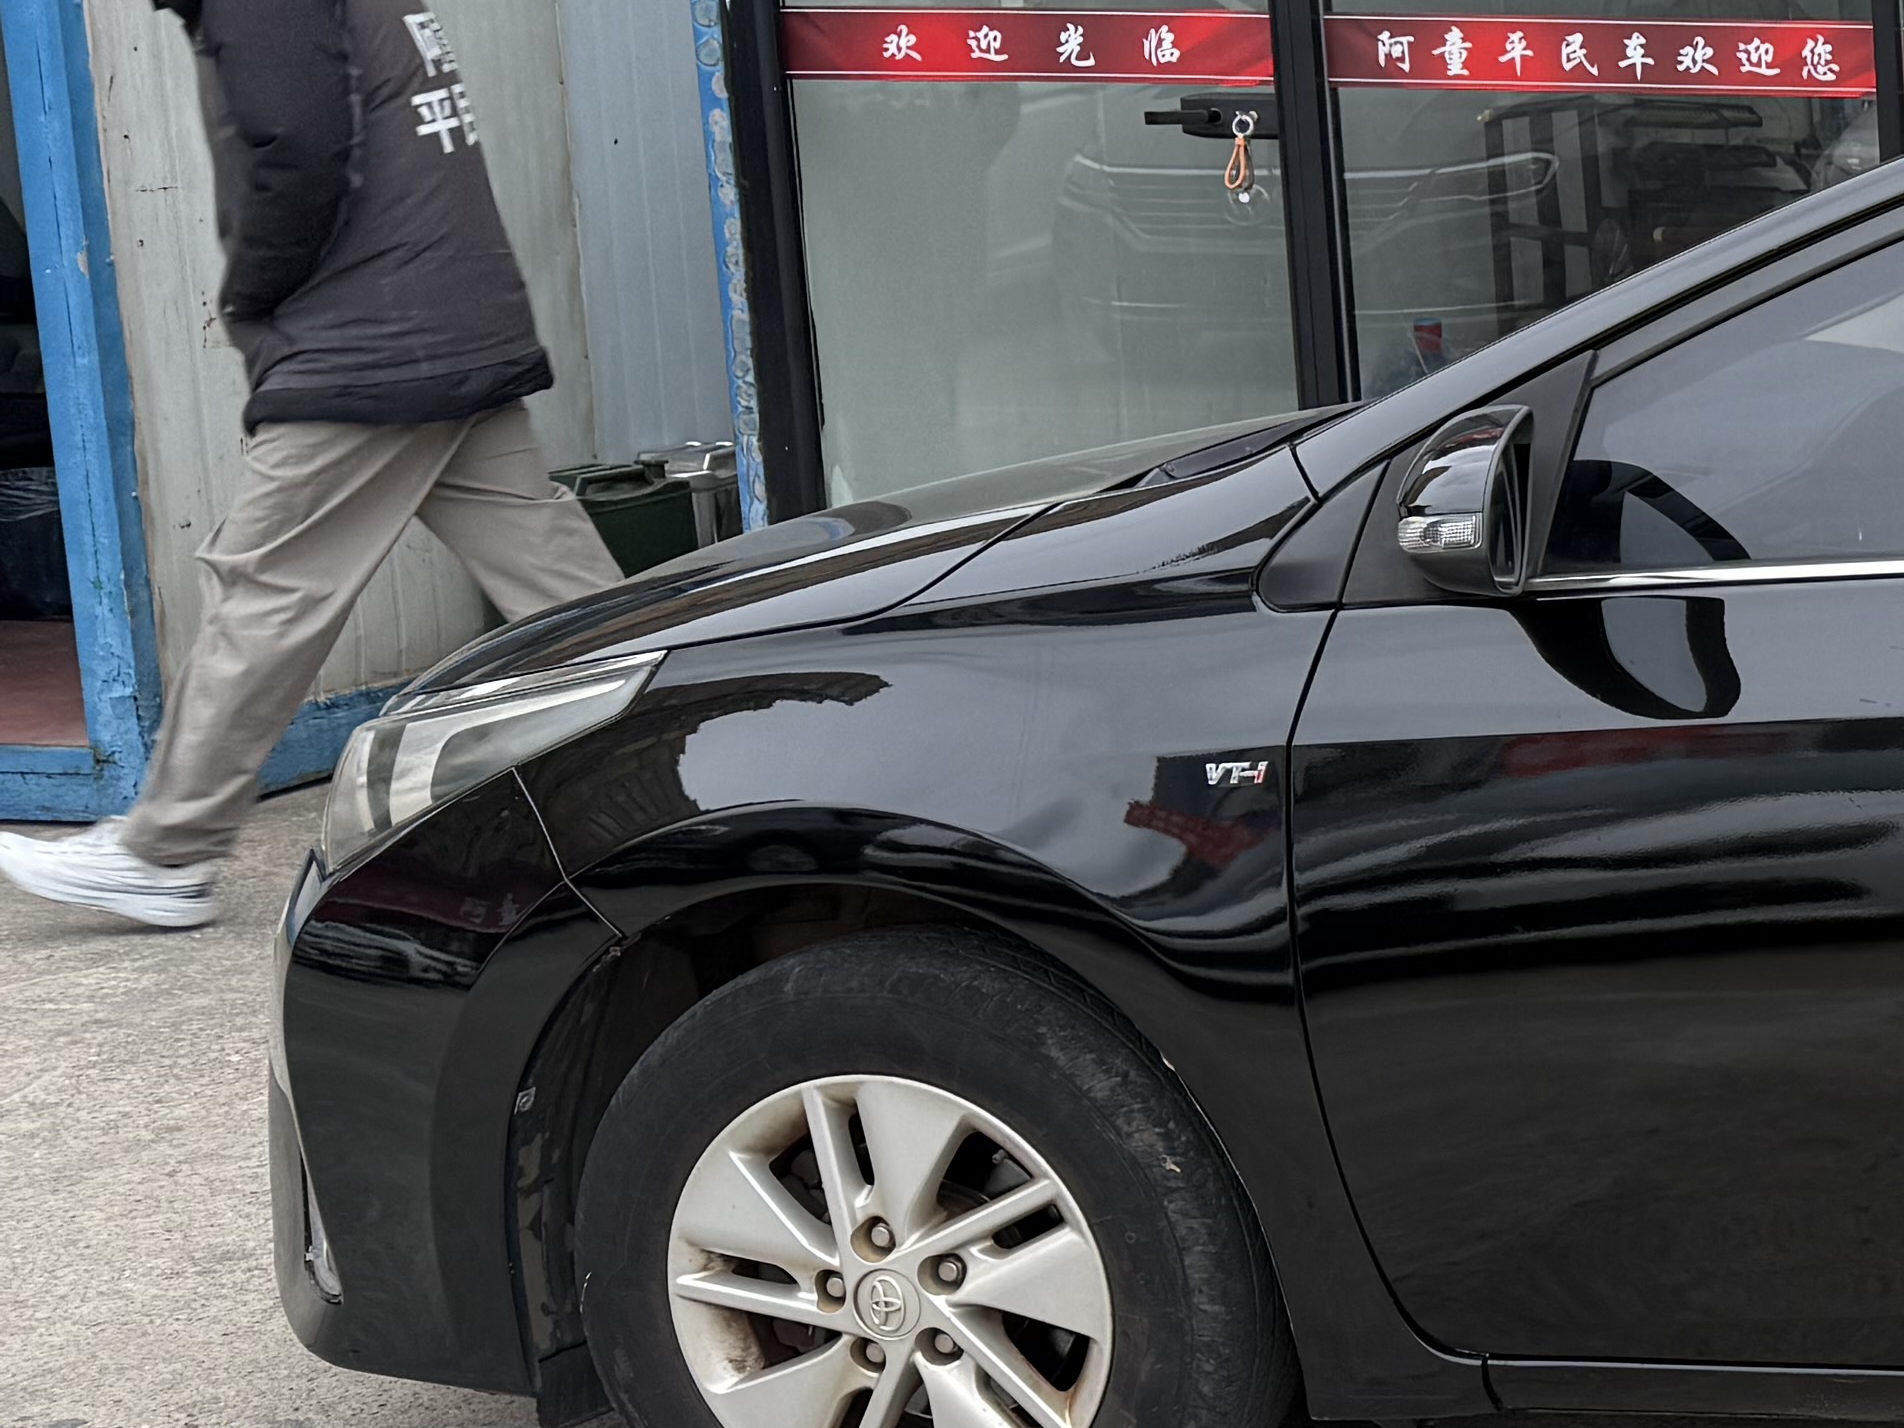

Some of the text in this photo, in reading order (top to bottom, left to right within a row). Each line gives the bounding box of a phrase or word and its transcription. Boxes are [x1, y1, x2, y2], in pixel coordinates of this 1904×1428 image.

[882, 24, 1182, 68] 欢迎光临
[1376, 31, 1842, 81] 阿童平民车欢迎您
